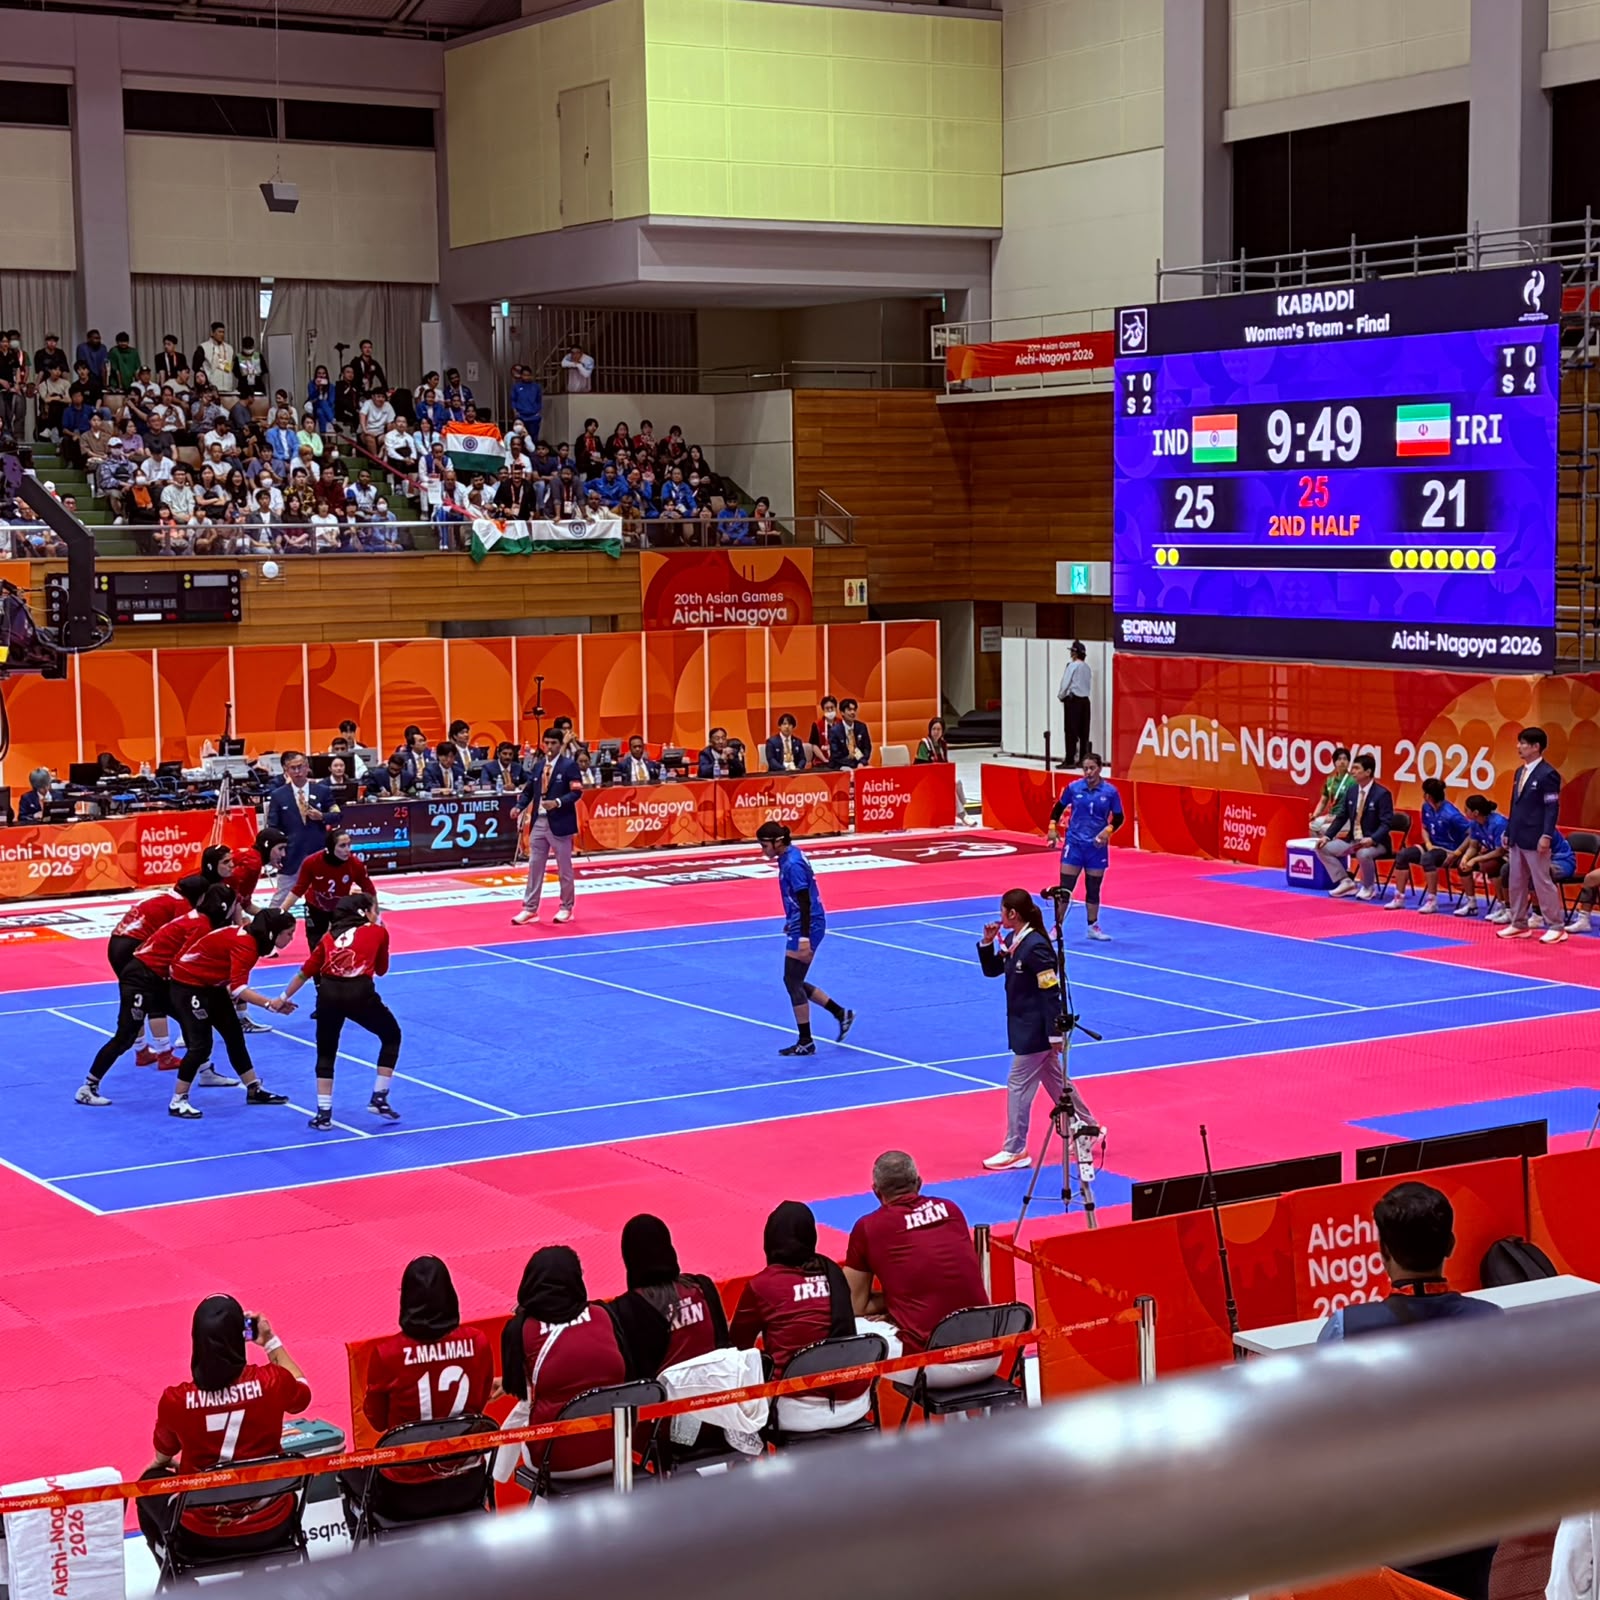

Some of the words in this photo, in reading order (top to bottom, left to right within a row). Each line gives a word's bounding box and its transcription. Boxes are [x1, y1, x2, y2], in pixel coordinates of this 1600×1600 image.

[1277, 289, 1355, 316] KABADDI
[1245, 323, 1304, 343] Women's
[1305, 320, 1344, 338] Team
[1356, 314, 1390, 334] Final
[1015, 352, 1071, 366] Aichi-Nagoya
[1072, 349, 1094, 360] 2026
[1503, 349, 1515, 368] T
[1525, 346, 1536, 366] 0
[1127, 375, 1136, 391] T
[1142, 373, 1152, 390] 0
[1502, 374, 1514, 393] S
[1524, 372, 1536, 392] 4
[1127, 397, 1136, 414] S
[1142, 396, 1152, 414] 2
[1266, 405, 1362, 463] 9:49
[1456, 413, 1503, 446] IRI
[1152, 428, 1189, 456] IND
[1298, 475, 1329, 508] 25
[1174, 484, 1214, 529] 25
[1421, 478, 1466, 528] 21
[1268, 516, 1305, 537] 2ND
[1310, 514, 1361, 536] HALF
[674, 592, 702, 605] 20th
[706, 592, 738, 604] Asian
[741, 591, 784, 603] Games
[672, 605, 788, 626] Aichi-Nagoya
[1122, 619, 1176, 636] BORNAN
[1392, 632, 1498, 658] Aichi-Nagoya
[1500, 636, 1542, 656] 2026
[1394, 739, 1495, 790] 2026
[862, 778, 900, 793] Aichi-
[428, 802, 459, 815] RAID
[461, 800, 500, 812] TIMER
[594, 800, 694, 818] Aichi-Nagoya
[735, 791, 829, 808] Aichi-Nagoya
[861, 792, 912, 808] Nagoya
[394, 806, 408, 818] 25
[764, 807, 800, 822] 2026
[863, 807, 894, 821] 2026
[1224, 804, 1257, 820] Aichi-
[140, 825, 188, 843] Aichi-
[394, 827, 408, 840] 21
[431, 813, 498, 849] 25.2
[625, 817, 662, 833] 2026
[1223, 819, 1266, 840] Nagoya
[0, 840, 112, 862] ichi-Nagoya
[140, 841, 202, 860] Nagoya
[1223, 836, 1251, 852] 2026
[28, 861, 74, 878] 2026
[143, 858, 182, 875] 2026
[327, 879, 336, 893] 2
[133, 993, 143, 1008] 3
[191, 995, 200, 1009] 6
[904, 1202, 949, 1230] IRAN
[1308, 1214, 1380, 1253] Aichi
[1308, 1252, 1385, 1288] Nago
[793, 1281, 830, 1301] IRA
[402, 1338, 475, 1366] Z.MALMALI
[417, 1365, 470, 1420] 12
[205, 1408, 246, 1463] 7
[45, 1476, 68, 1597] Aichi-Nagya
[68, 1509, 88, 1557] 2026
